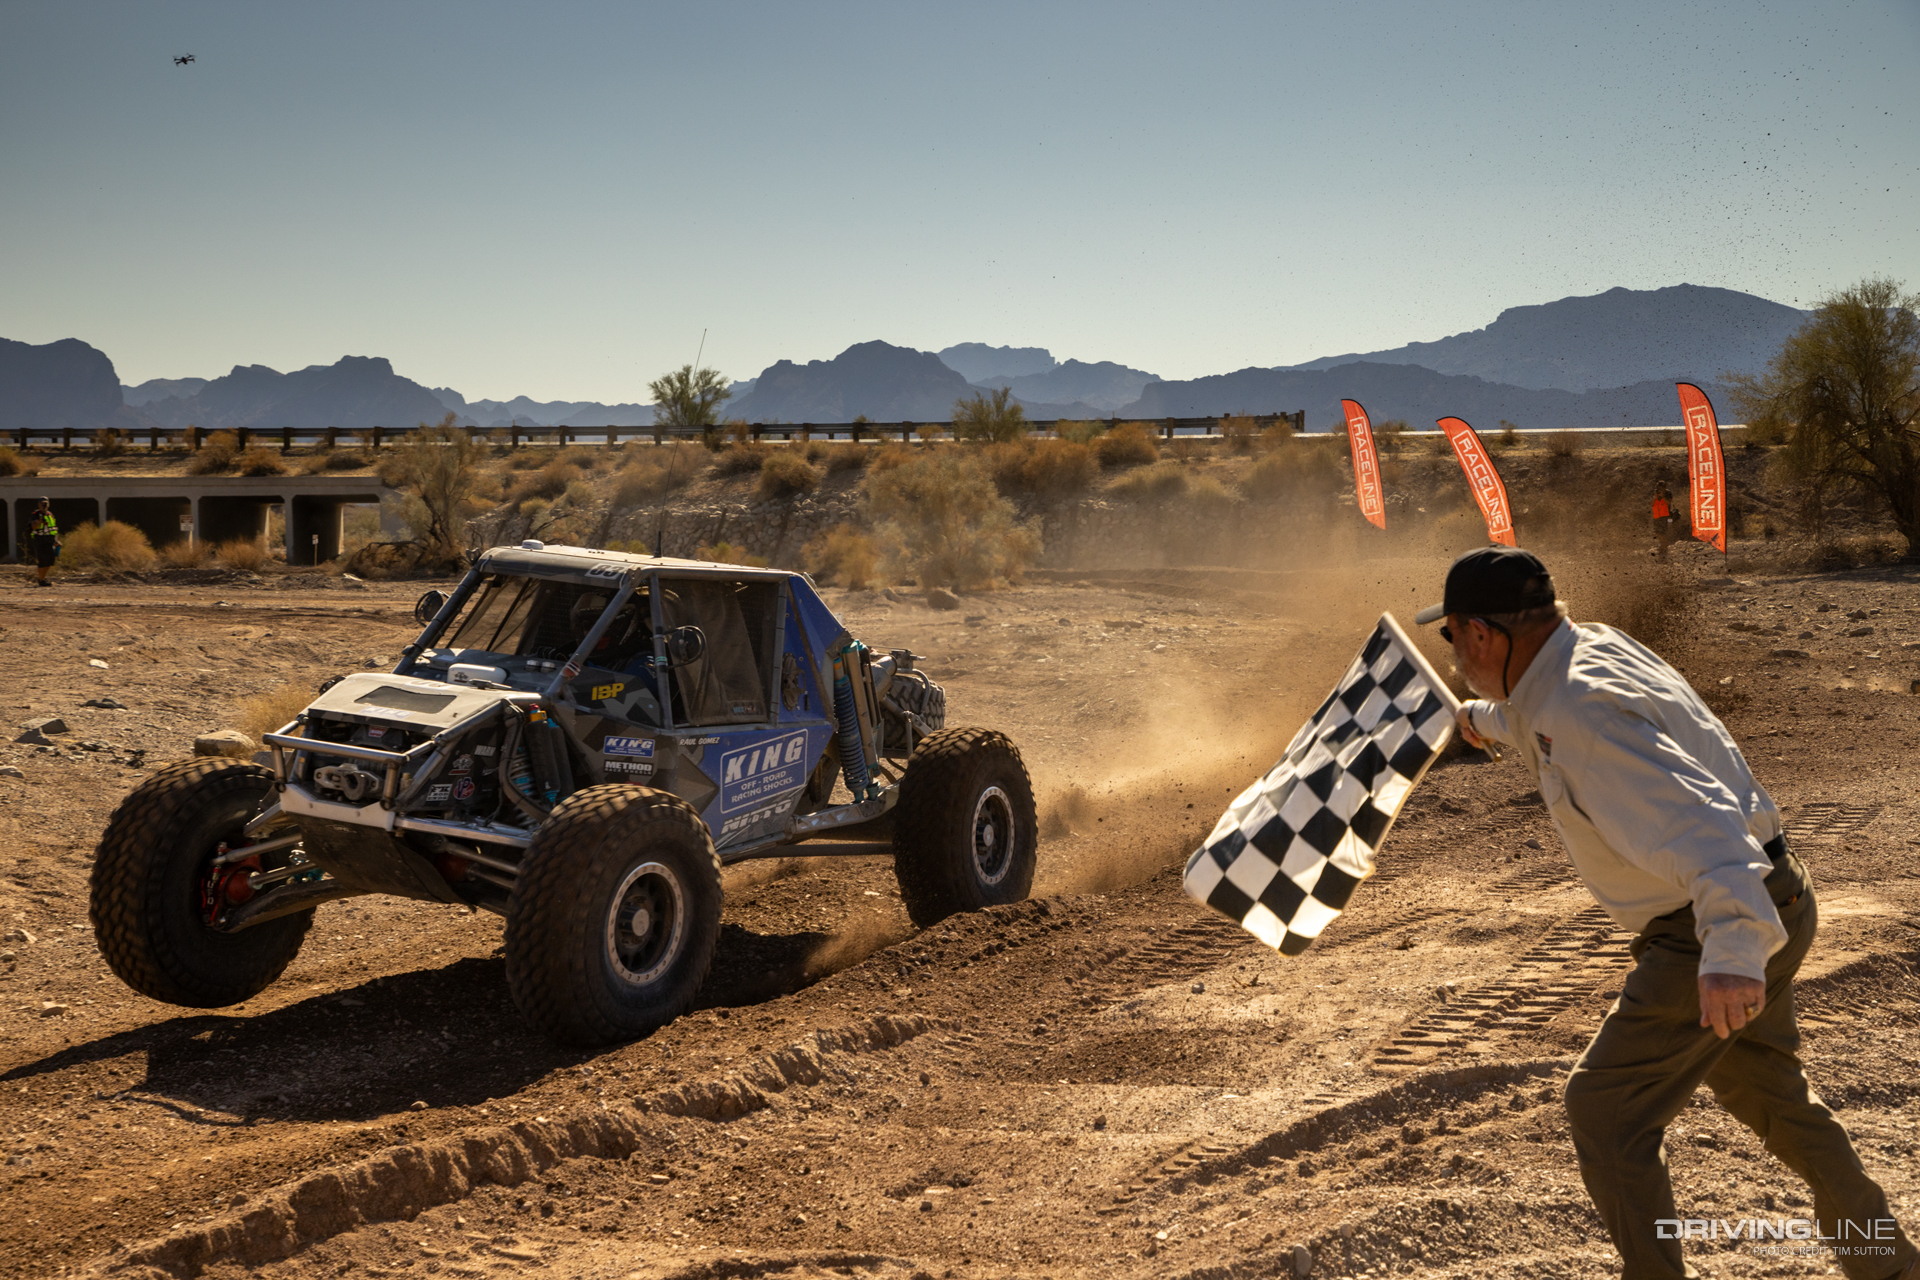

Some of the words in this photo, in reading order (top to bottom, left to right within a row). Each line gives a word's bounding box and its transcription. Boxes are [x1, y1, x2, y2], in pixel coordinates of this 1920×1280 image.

[1353, 422, 1377, 510] RACELINE
[1692, 413, 1716, 524] RACELINE
[1458, 436, 1505, 528] RACELINE
[591, 682, 625, 701] IBP
[606, 738, 653, 749] KING
[679, 738, 697, 746] RAUL
[697, 736, 720, 745] GOMEZ
[605, 761, 653, 772] METHOD
[724, 736, 804, 784] KING
[731, 787, 761, 803] RACING
[762, 777, 793, 792] SHOCKS
